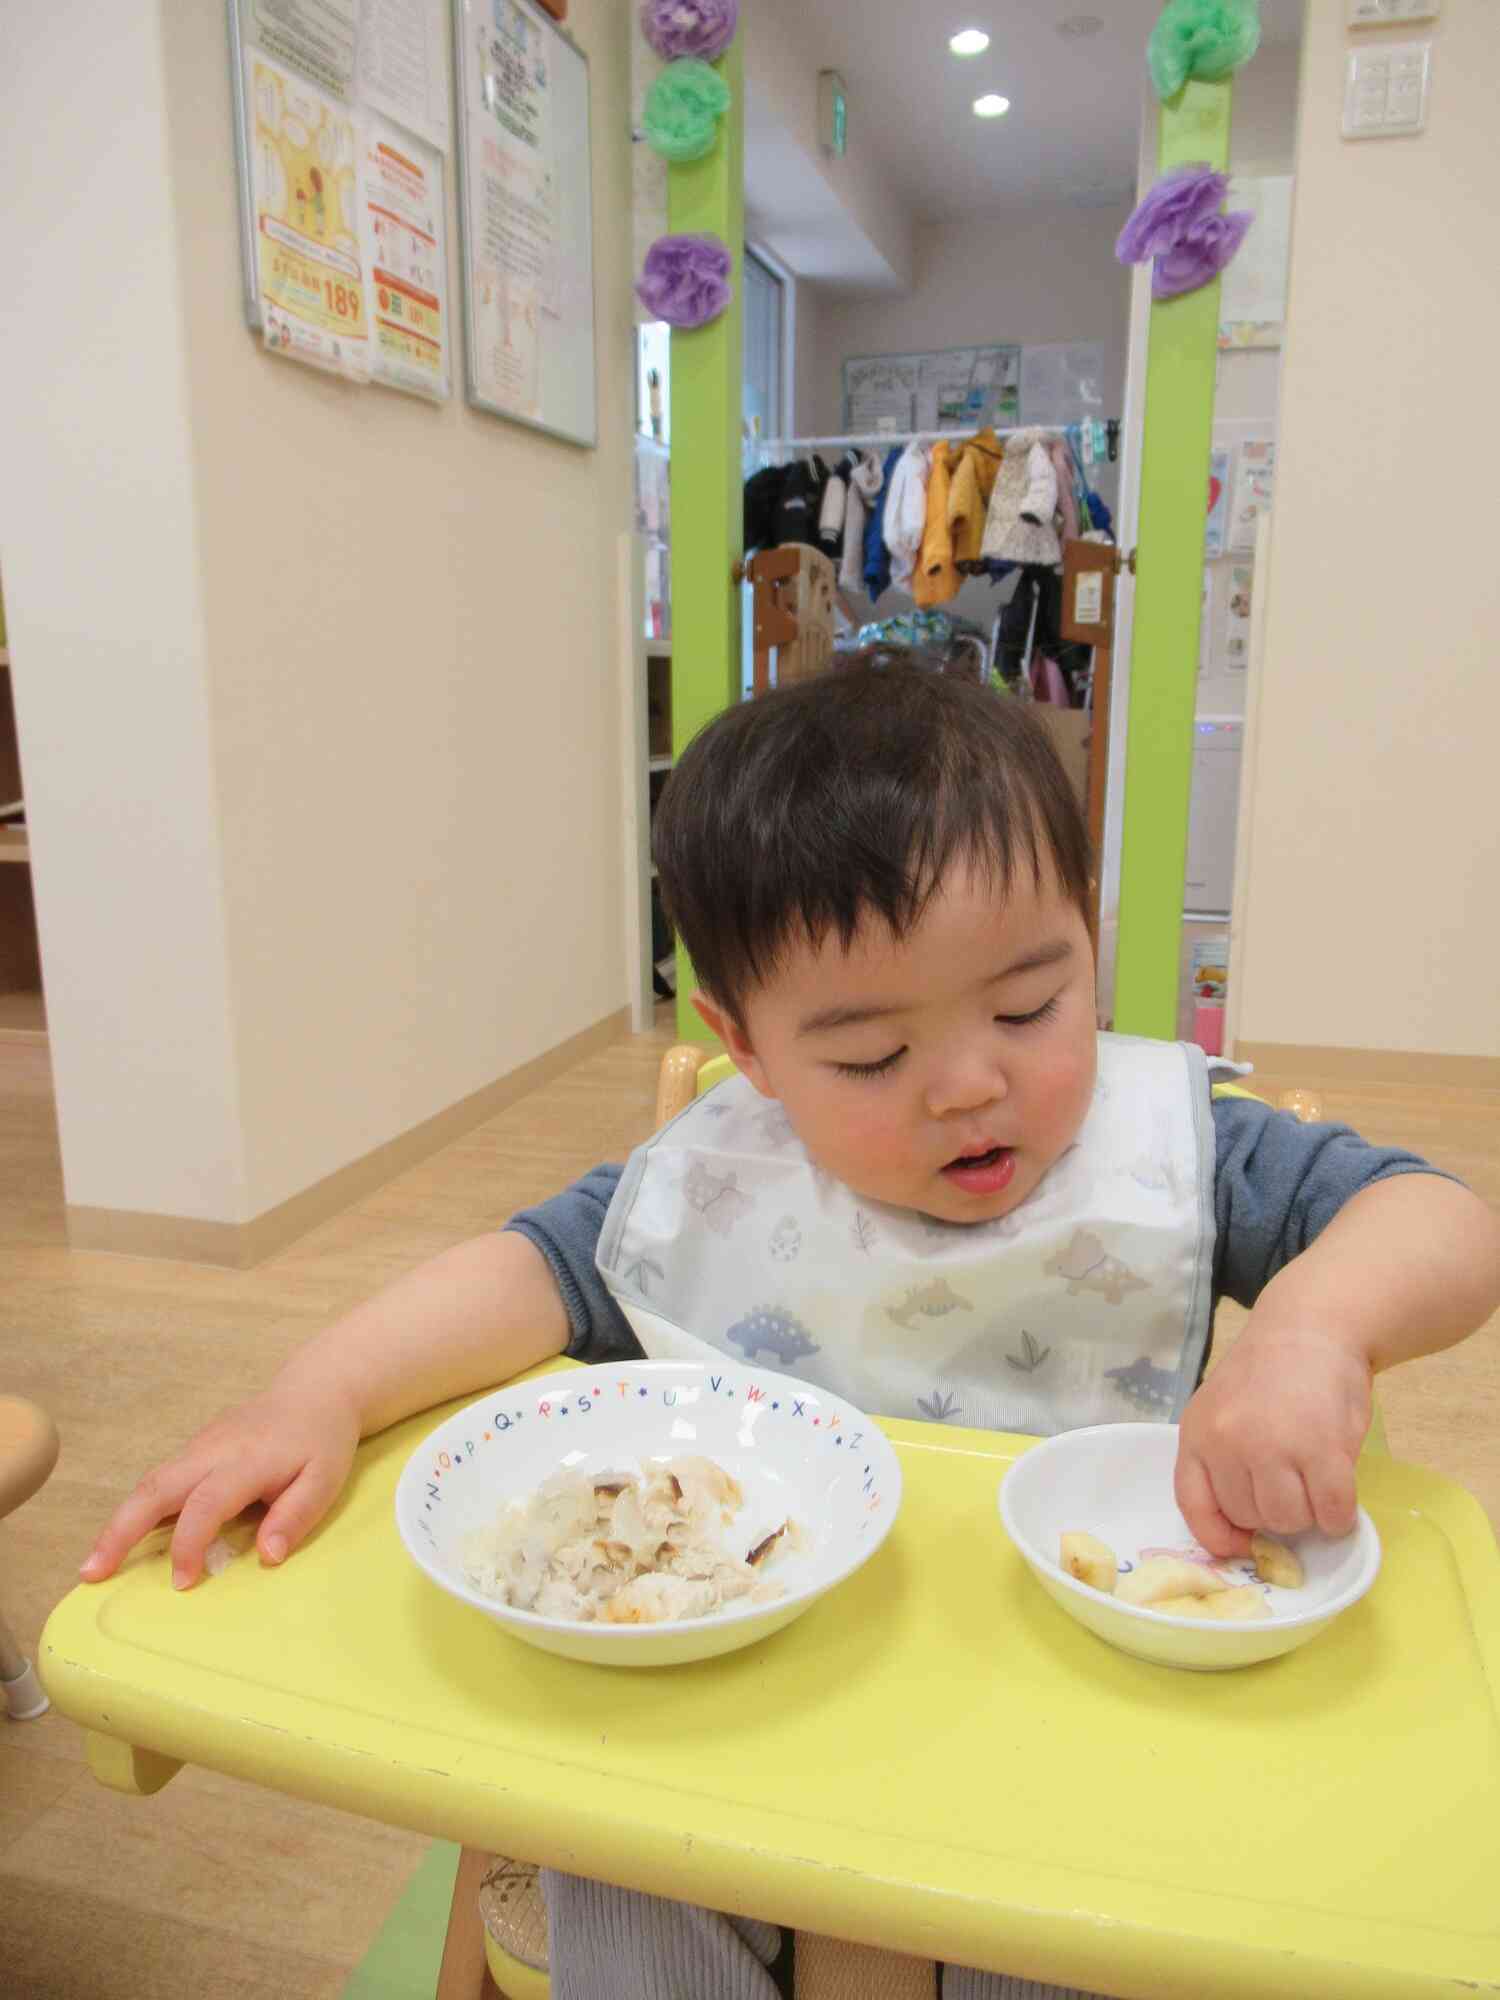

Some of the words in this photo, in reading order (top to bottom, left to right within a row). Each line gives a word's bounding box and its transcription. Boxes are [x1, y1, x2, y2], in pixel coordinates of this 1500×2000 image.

[325, 280, 359, 320] 189
[465, 1441, 475, 1456] P
[495, 1413, 513, 1430] Q
[538, 1402, 551, 1417] R
[578, 1396, 591, 1412] S
[617, 1382, 629, 1396] T
[663, 1391, 677, 1406] U
[711, 1376, 722, 1391] V
[747, 1385, 766, 1402] W
[792, 1400, 804, 1416] X
[850, 1433, 863, 1448] Z
